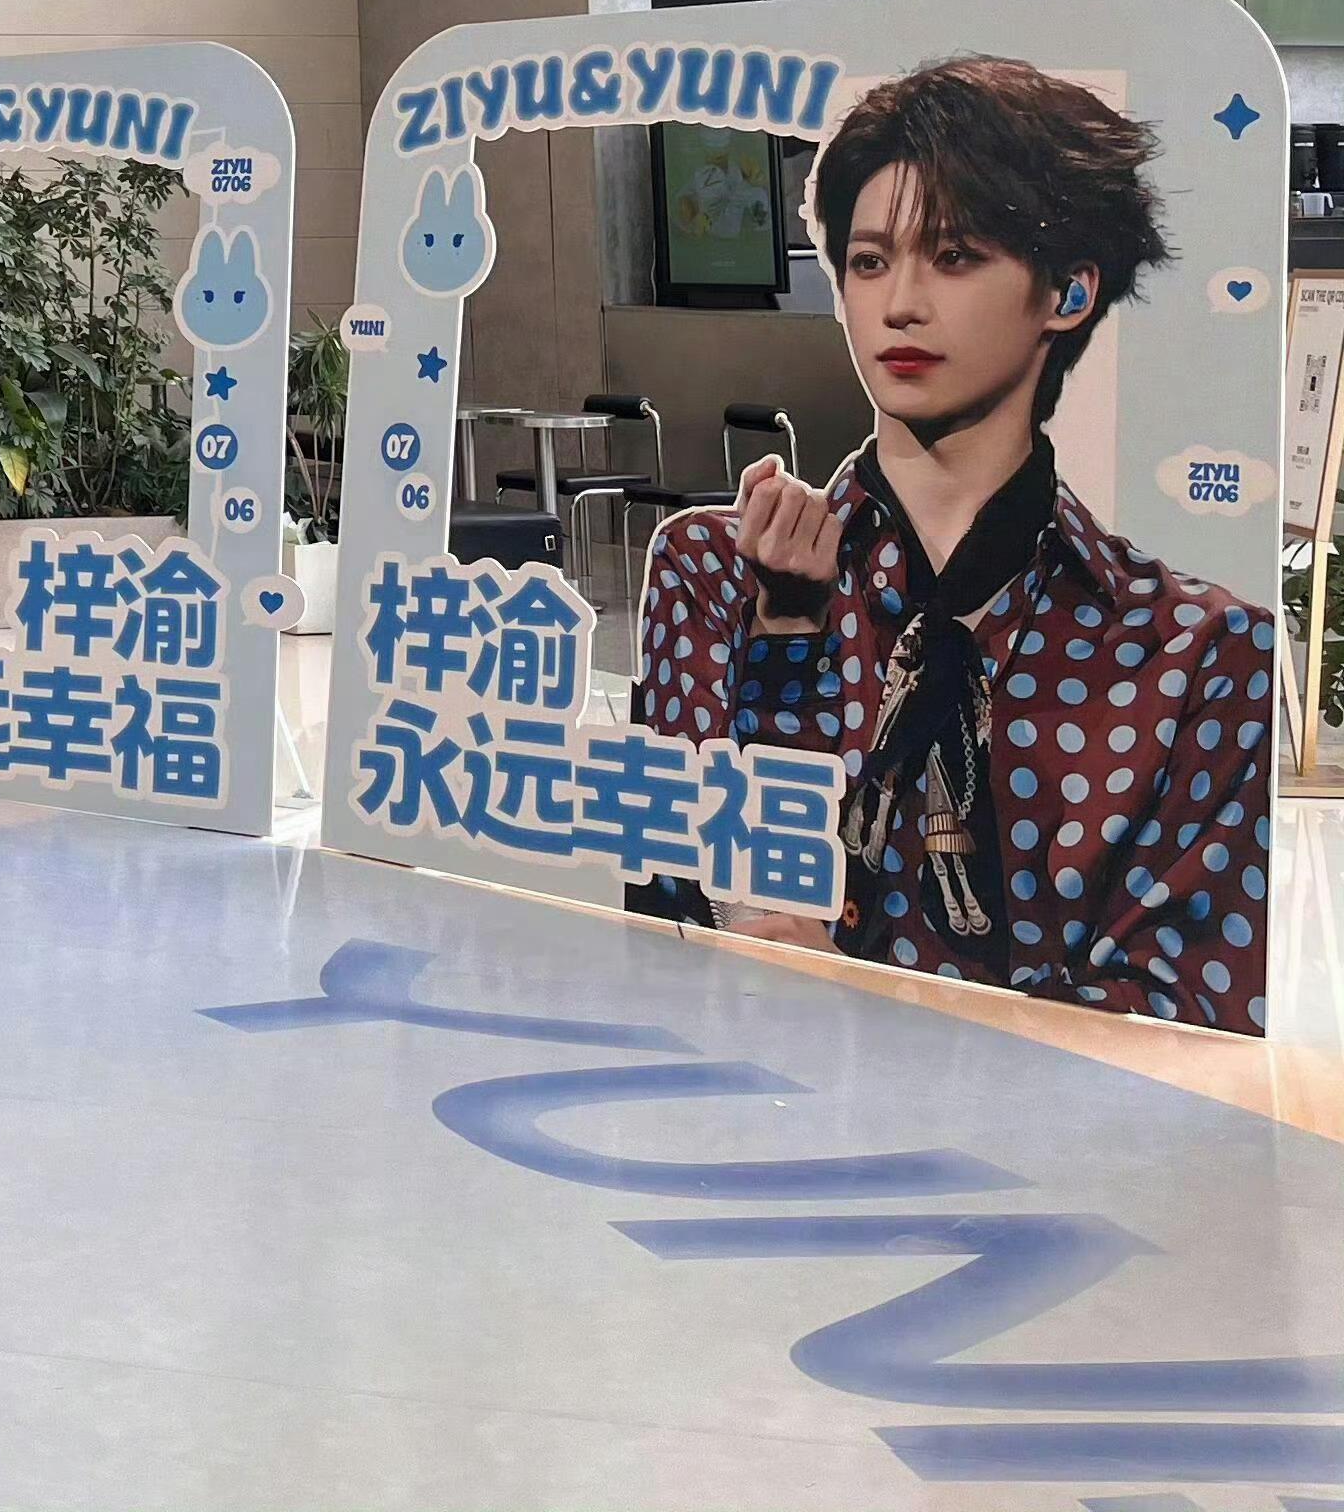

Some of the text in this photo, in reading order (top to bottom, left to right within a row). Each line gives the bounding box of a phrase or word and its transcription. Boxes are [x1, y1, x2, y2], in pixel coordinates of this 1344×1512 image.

[398, 48, 838, 152] ZIYU&YUNI
[211, 158, 252, 175] ZIYU
[212, 175, 252, 192] 0706
[350, 318, 385, 337] YUNI
[200, 434, 232, 459] 07
[386, 434, 416, 459] 07
[1188, 462, 1241, 482] ZIYU
[401, 485, 430, 510] 06
[1188, 482, 1239, 502] 0706
[224, 498, 255, 522] 06
[15, 540, 221, 668] 梓渝
[367, 561, 582, 710] 梓渝
[355, 702, 835, 909] 永远幸福
[194, 936, 1344, 1512] YUNI
